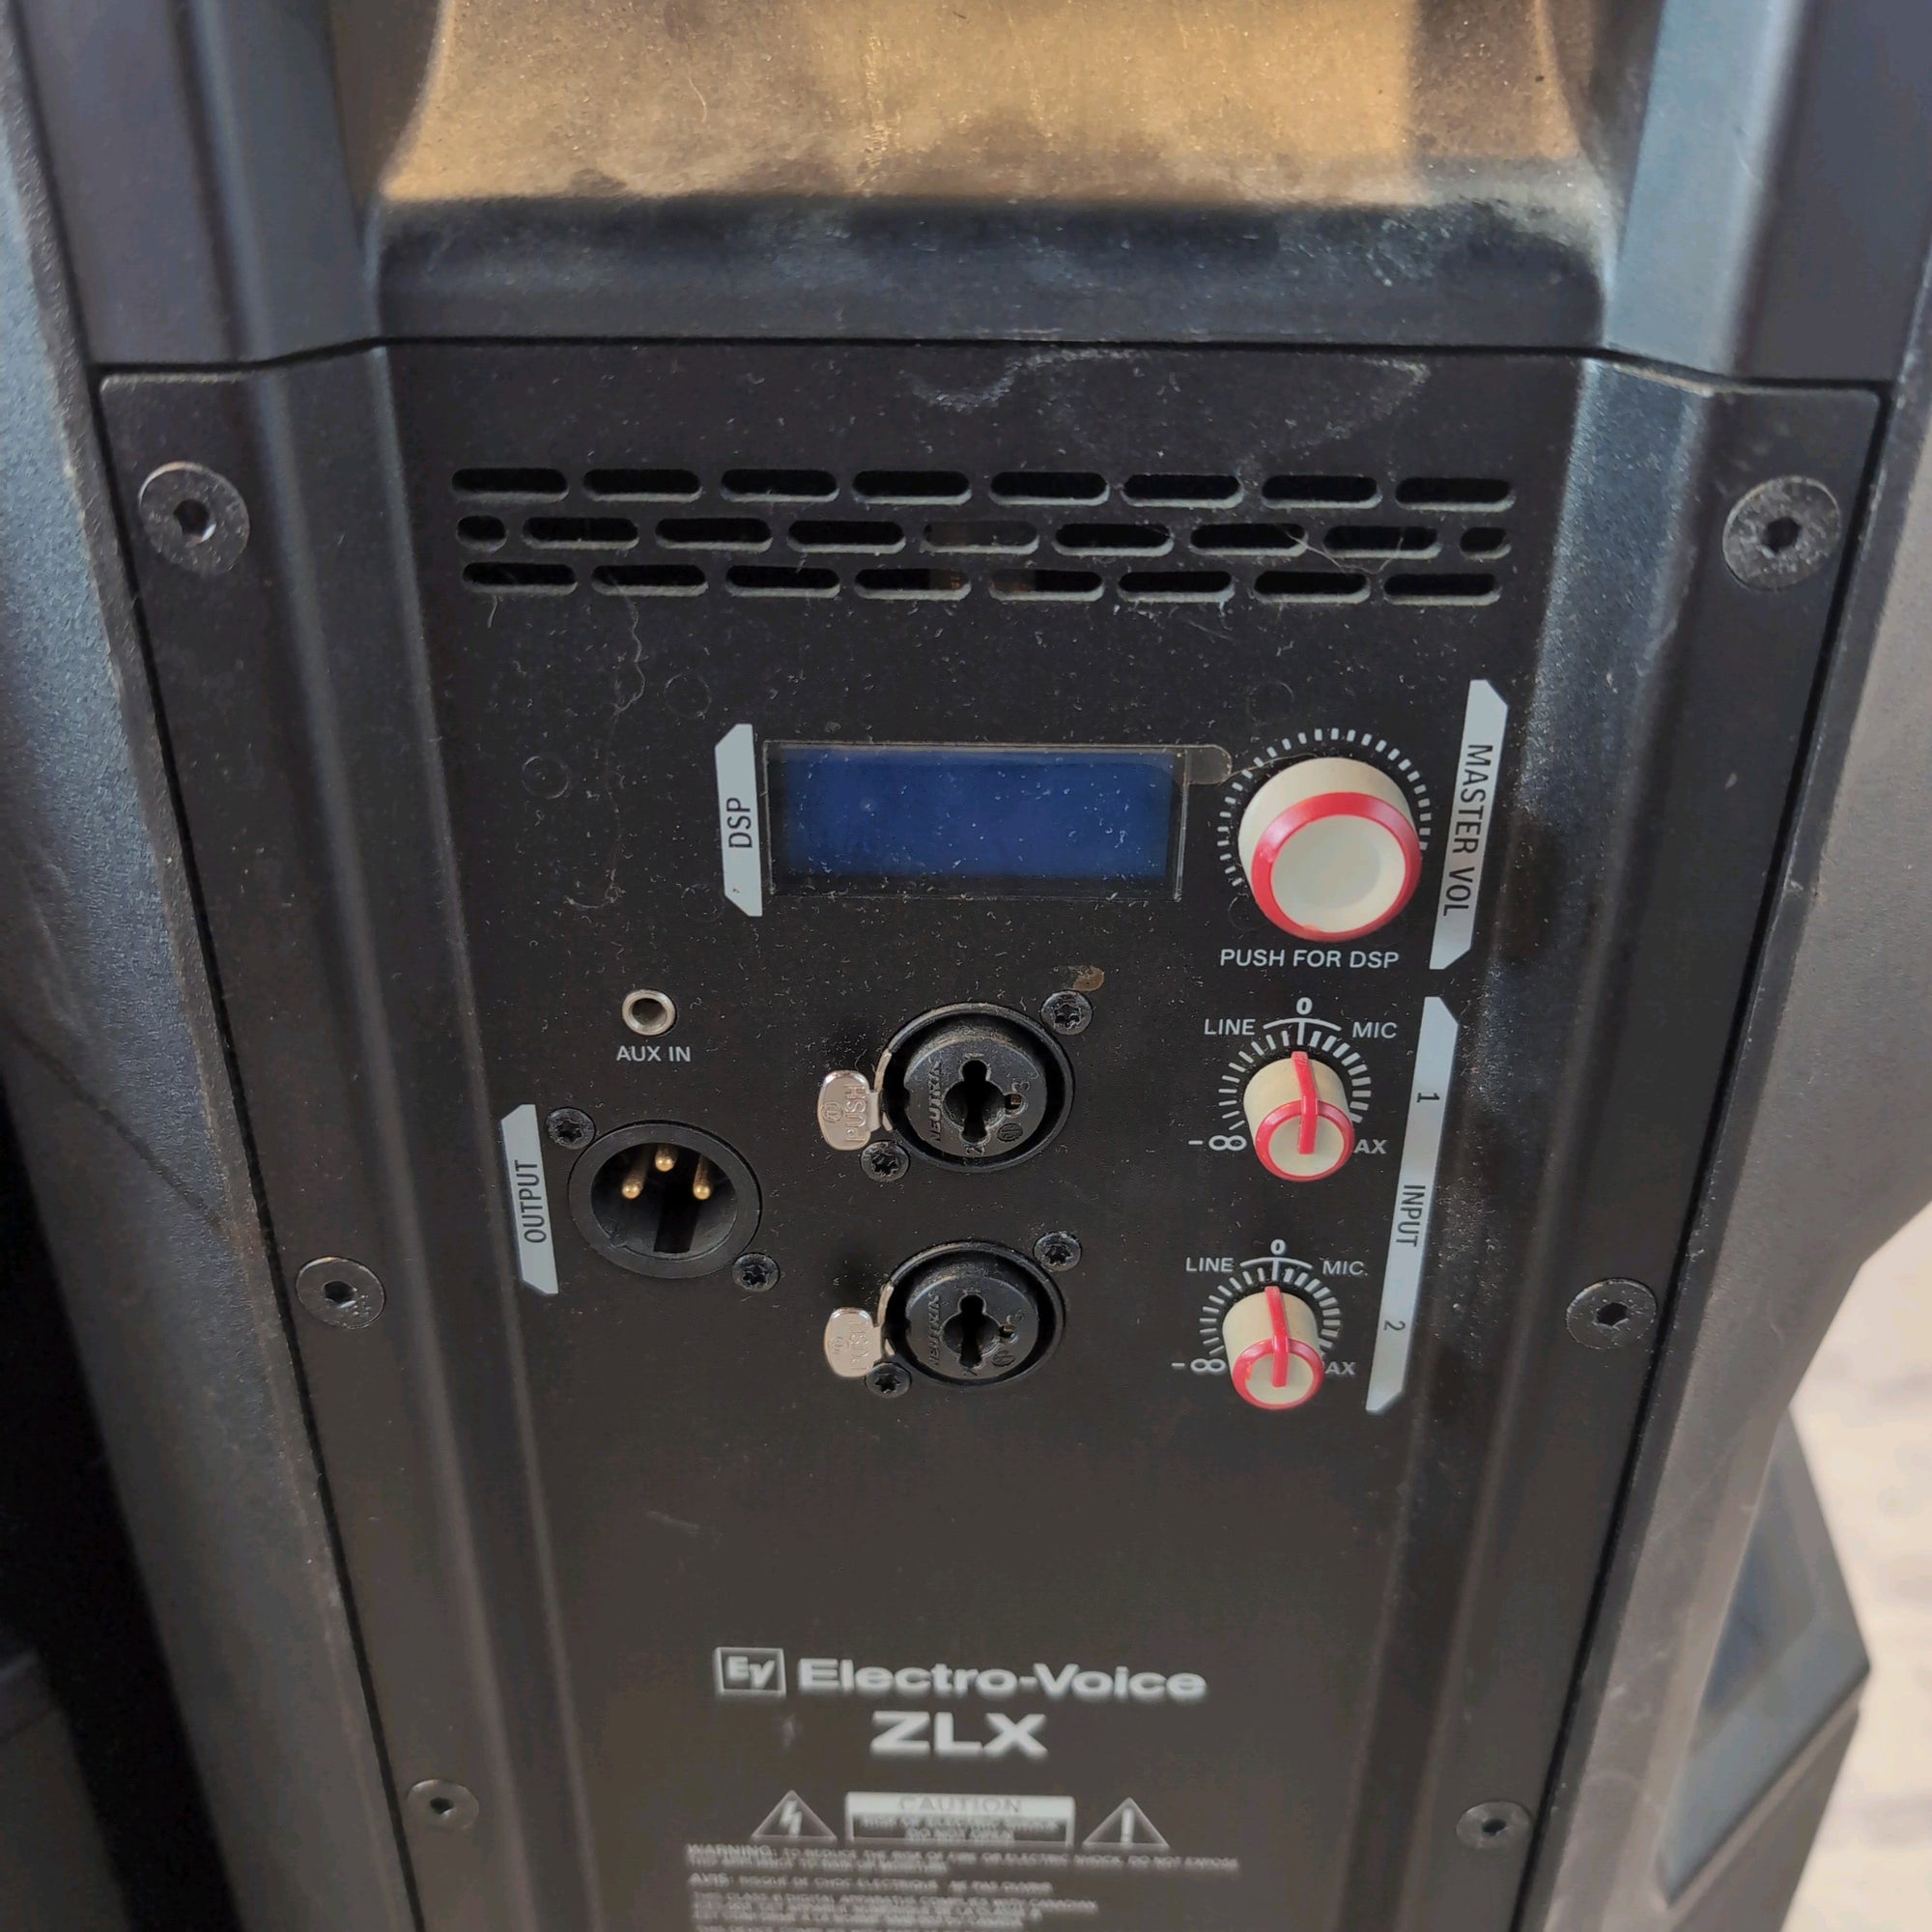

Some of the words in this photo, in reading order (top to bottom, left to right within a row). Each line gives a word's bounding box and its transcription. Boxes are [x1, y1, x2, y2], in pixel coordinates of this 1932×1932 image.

[1452, 744, 1493, 855] MASTER
[725, 797, 753, 849] DSP
[1442, 868, 1474, 918] VOL
[1219, 949, 1286, 967] PUSH
[1292, 950, 1342, 968] FOR
[1350, 951, 1400, 969] DSP
[1295, 997, 1313, 1014] 0
[1204, 1018, 1256, 1036] LINE
[1351, 1021, 1398, 1038] MIC
[615, 1045, 662, 1063] AUX
[668, 1045, 692, 1063] IN
[1416, 1092, 1440, 1104] 1
[844, 1084, 867, 1143] PUSH
[1352, 1138, 1388, 1155] AX
[514, 1159, 548, 1244] OUTPUT
[1396, 1184, 1427, 1248] INPUT
[1270, 1238, 1286, 1256] 0
[1185, 1257, 1234, 1273] LINE
[1322, 1260, 1365, 1276] MIC
[1382, 1319, 1406, 1332] 2
[1324, 1360, 1357, 1376] AX
[797, 1657, 1208, 1700] Electro-Voice
[869, 1710, 1048, 1757] ZLX
[897, 1795, 1023, 1814] CAUTION
